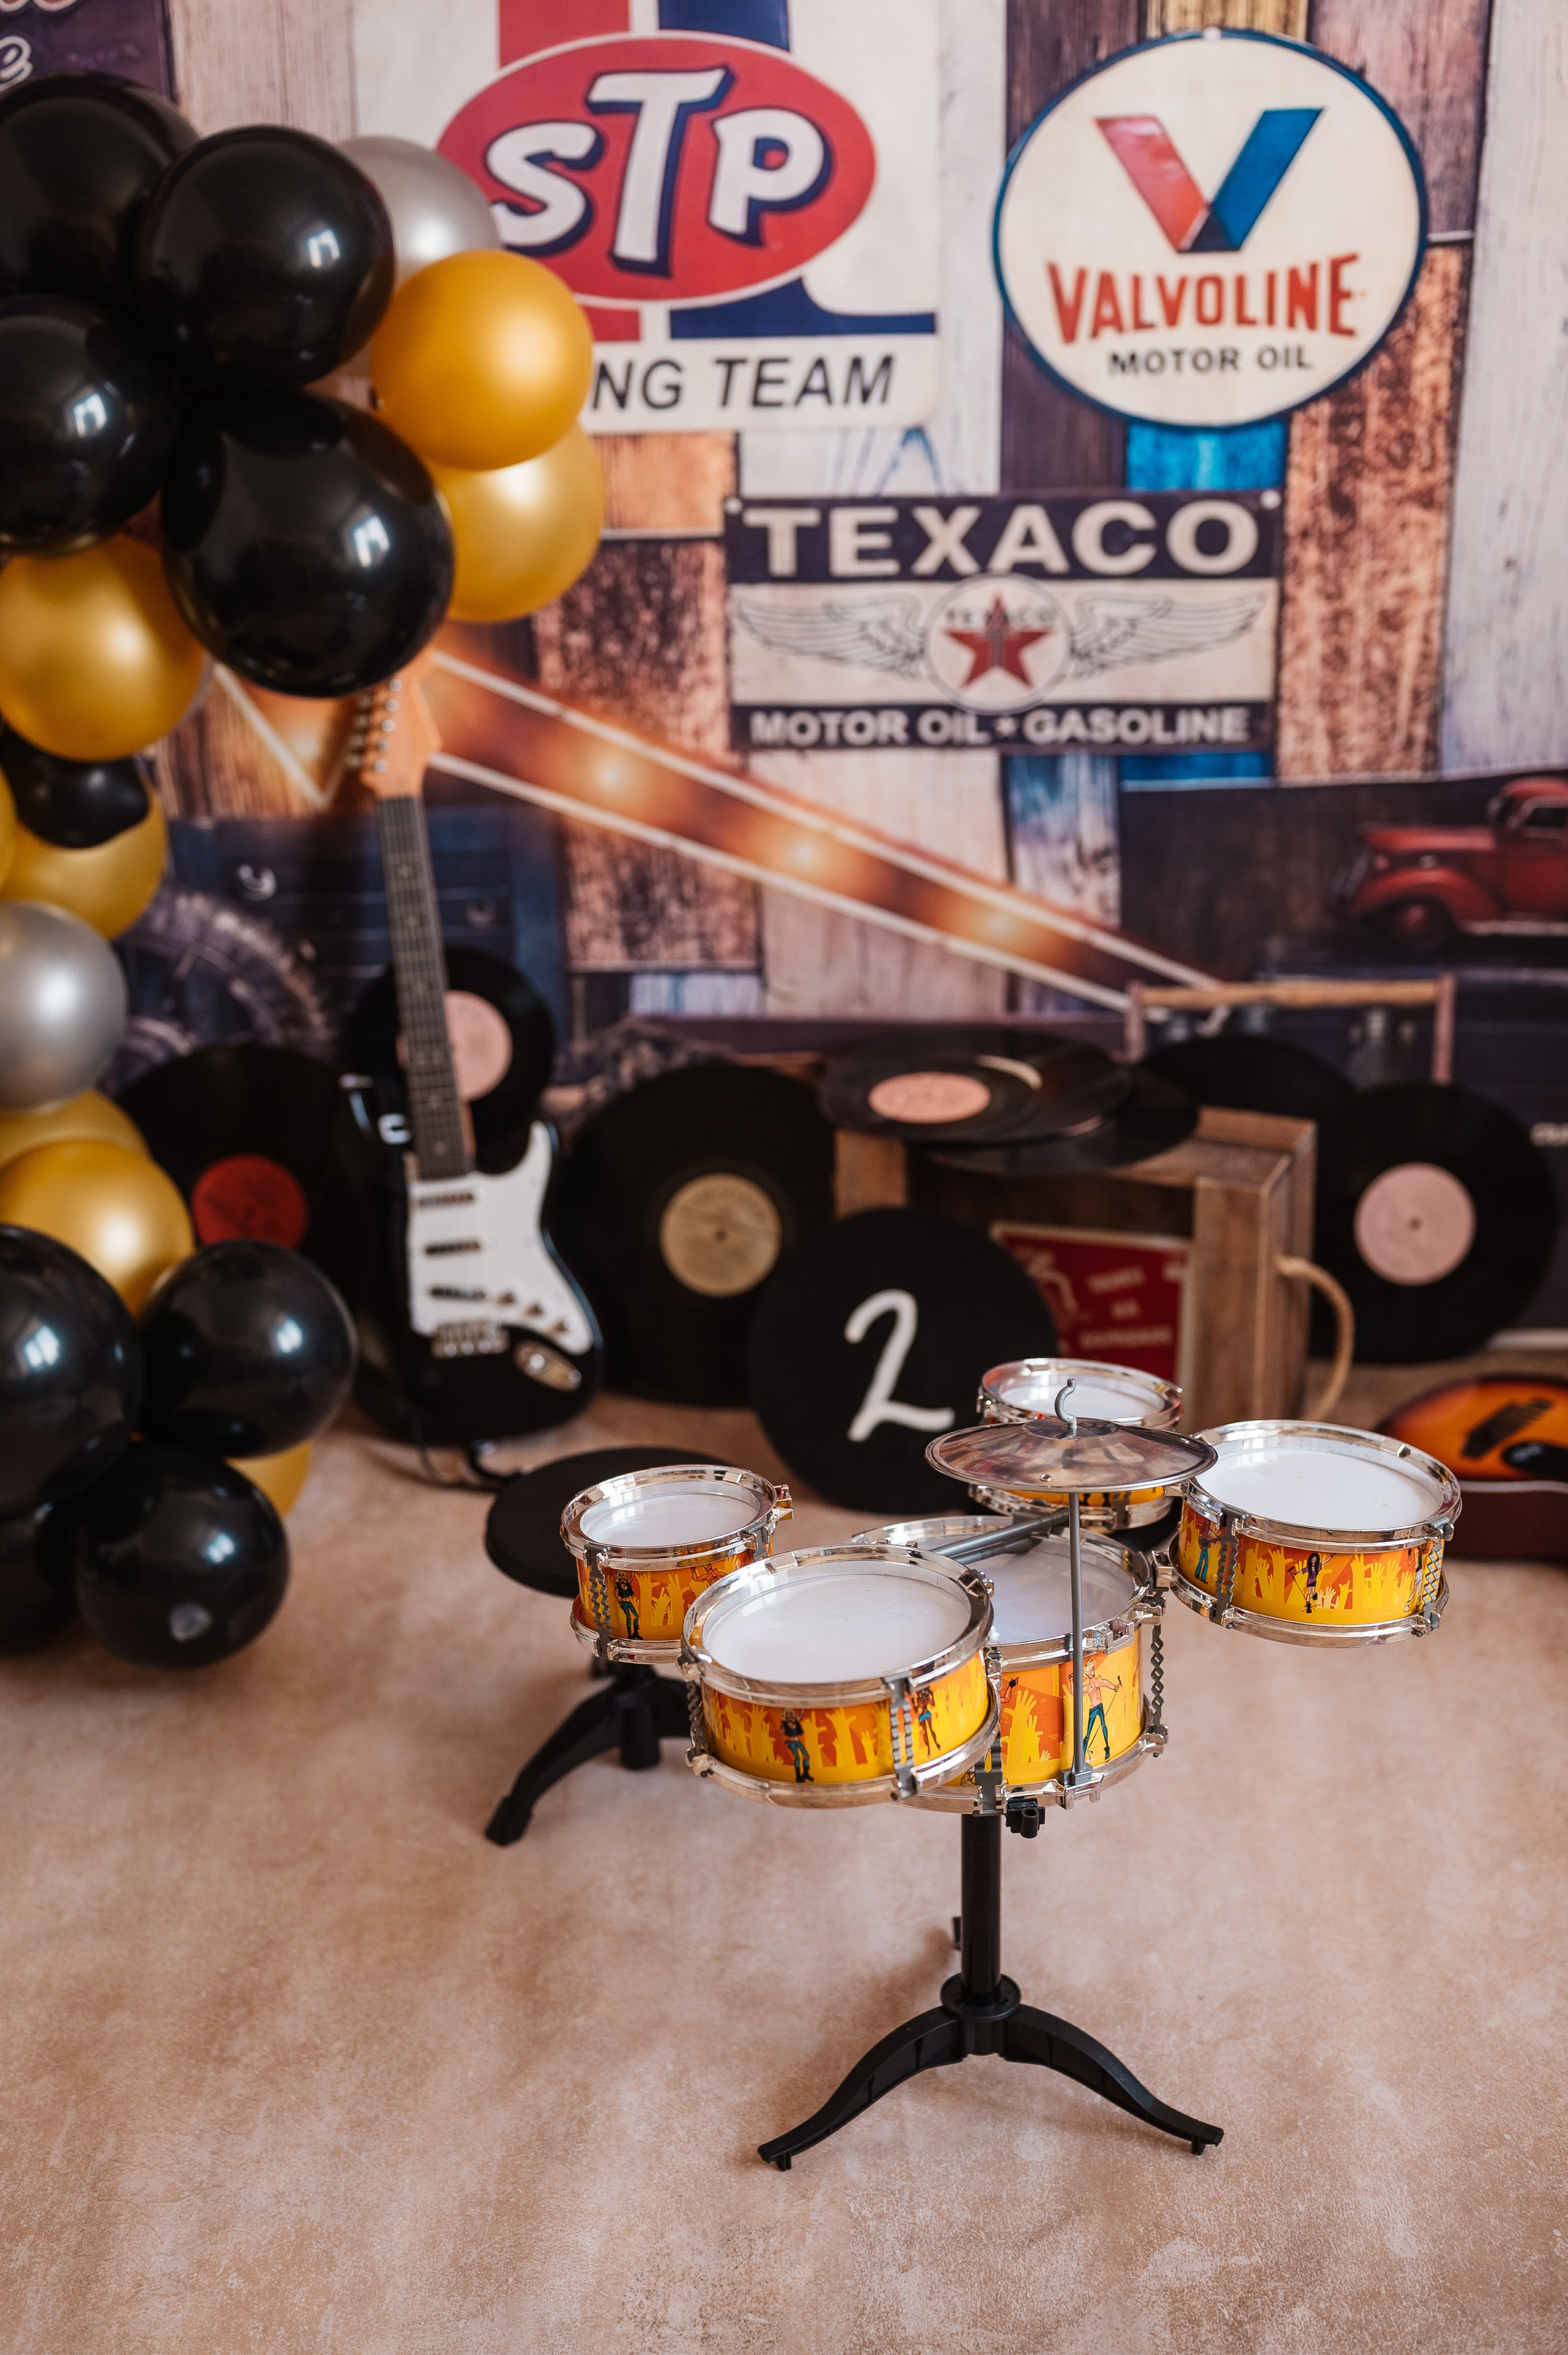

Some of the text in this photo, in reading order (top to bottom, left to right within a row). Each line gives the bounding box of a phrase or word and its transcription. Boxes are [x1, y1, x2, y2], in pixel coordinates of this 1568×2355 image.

[485, 63, 833, 278] STP
[1046, 252, 1361, 346] VALVOLINE
[714, 354, 895, 410] TEAM
[1108, 344, 1312, 376] MOTOR OIL
[742, 499, 1260, 577] TEXACO
[749, 707, 1251, 746] MOTOR OIL GASOLINE
[845, 1289, 954, 1442] 2
